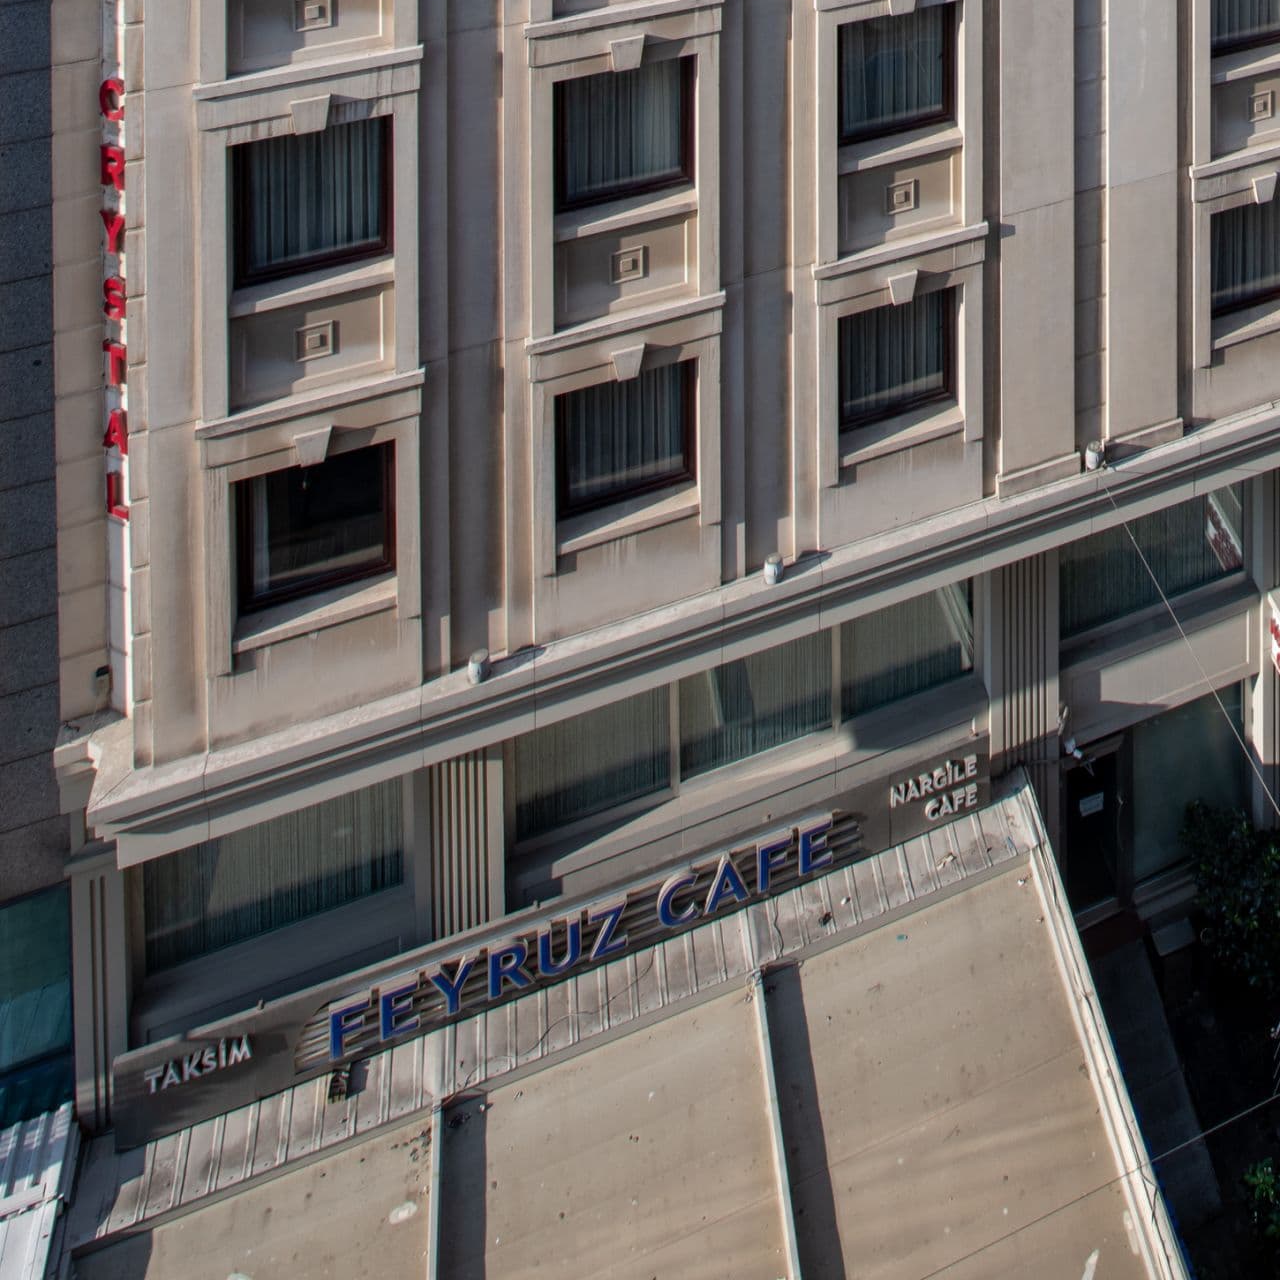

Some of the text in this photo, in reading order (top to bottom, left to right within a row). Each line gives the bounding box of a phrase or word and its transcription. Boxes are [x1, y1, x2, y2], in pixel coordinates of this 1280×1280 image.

[100, 78, 130, 521] CRYSTAL
[925, 783, 978, 821] CAFE
[328, 813, 835, 1061] FEYRUZ CAFE
